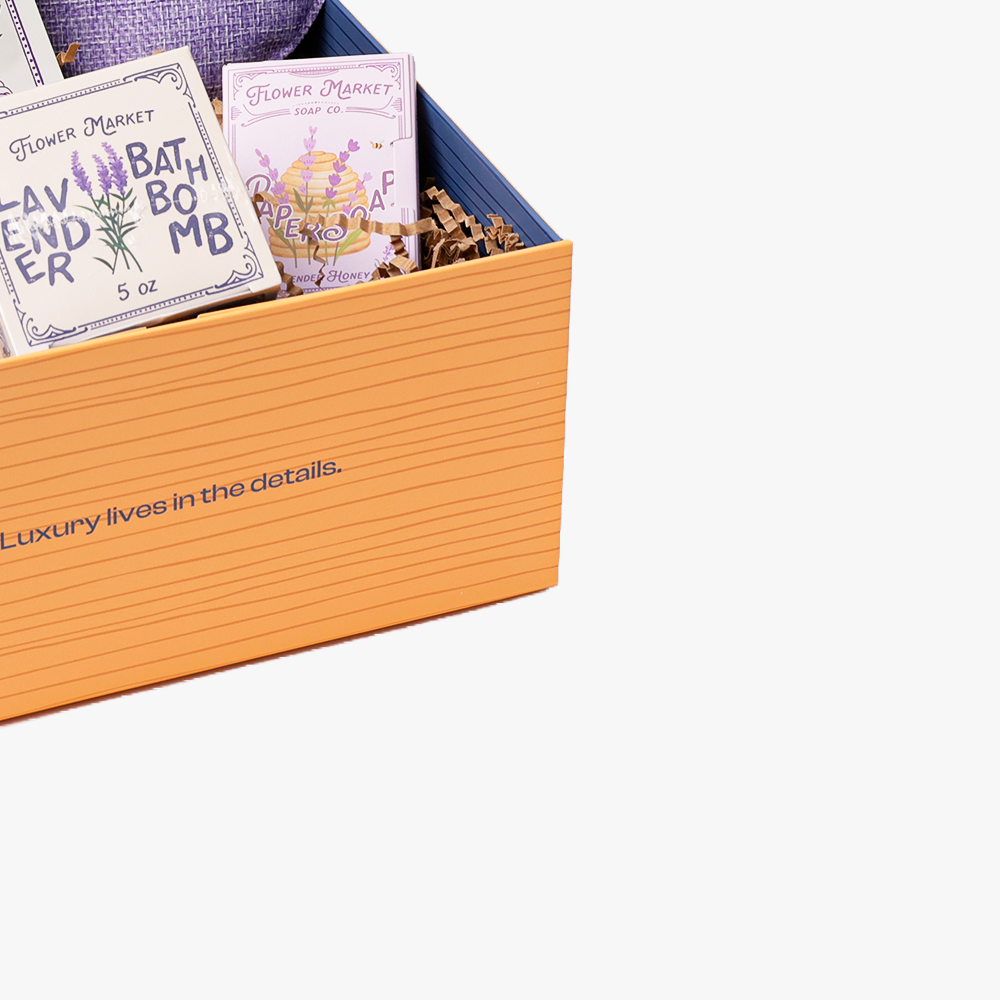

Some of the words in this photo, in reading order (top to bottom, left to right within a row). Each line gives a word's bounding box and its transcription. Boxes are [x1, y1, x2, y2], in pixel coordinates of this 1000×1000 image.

[246, 83, 312, 106] FLOWER
[320, 79, 394, 100] MARKET
[294, 106, 322, 116] SOAP
[326, 105, 344, 115] CO.
[9, 127, 77, 162] FLOWER
[83, 109, 155, 136] MARKET
[126, 137, 209, 185] BATH
[146, 179, 198, 216] BO
[1, 214, 91, 255] END
[168, 212, 234, 256] MB
[14, 250, 75, 286] ER
[327, 270, 371, 283] HONEY
[117, 282, 131, 301] 5
[0, 514, 102, 550] Luxury
[106, 500, 168, 526] lives
[172, 491, 196, 512] in
[200, 480, 245, 504] the
[250, 458, 343, 493] details.
